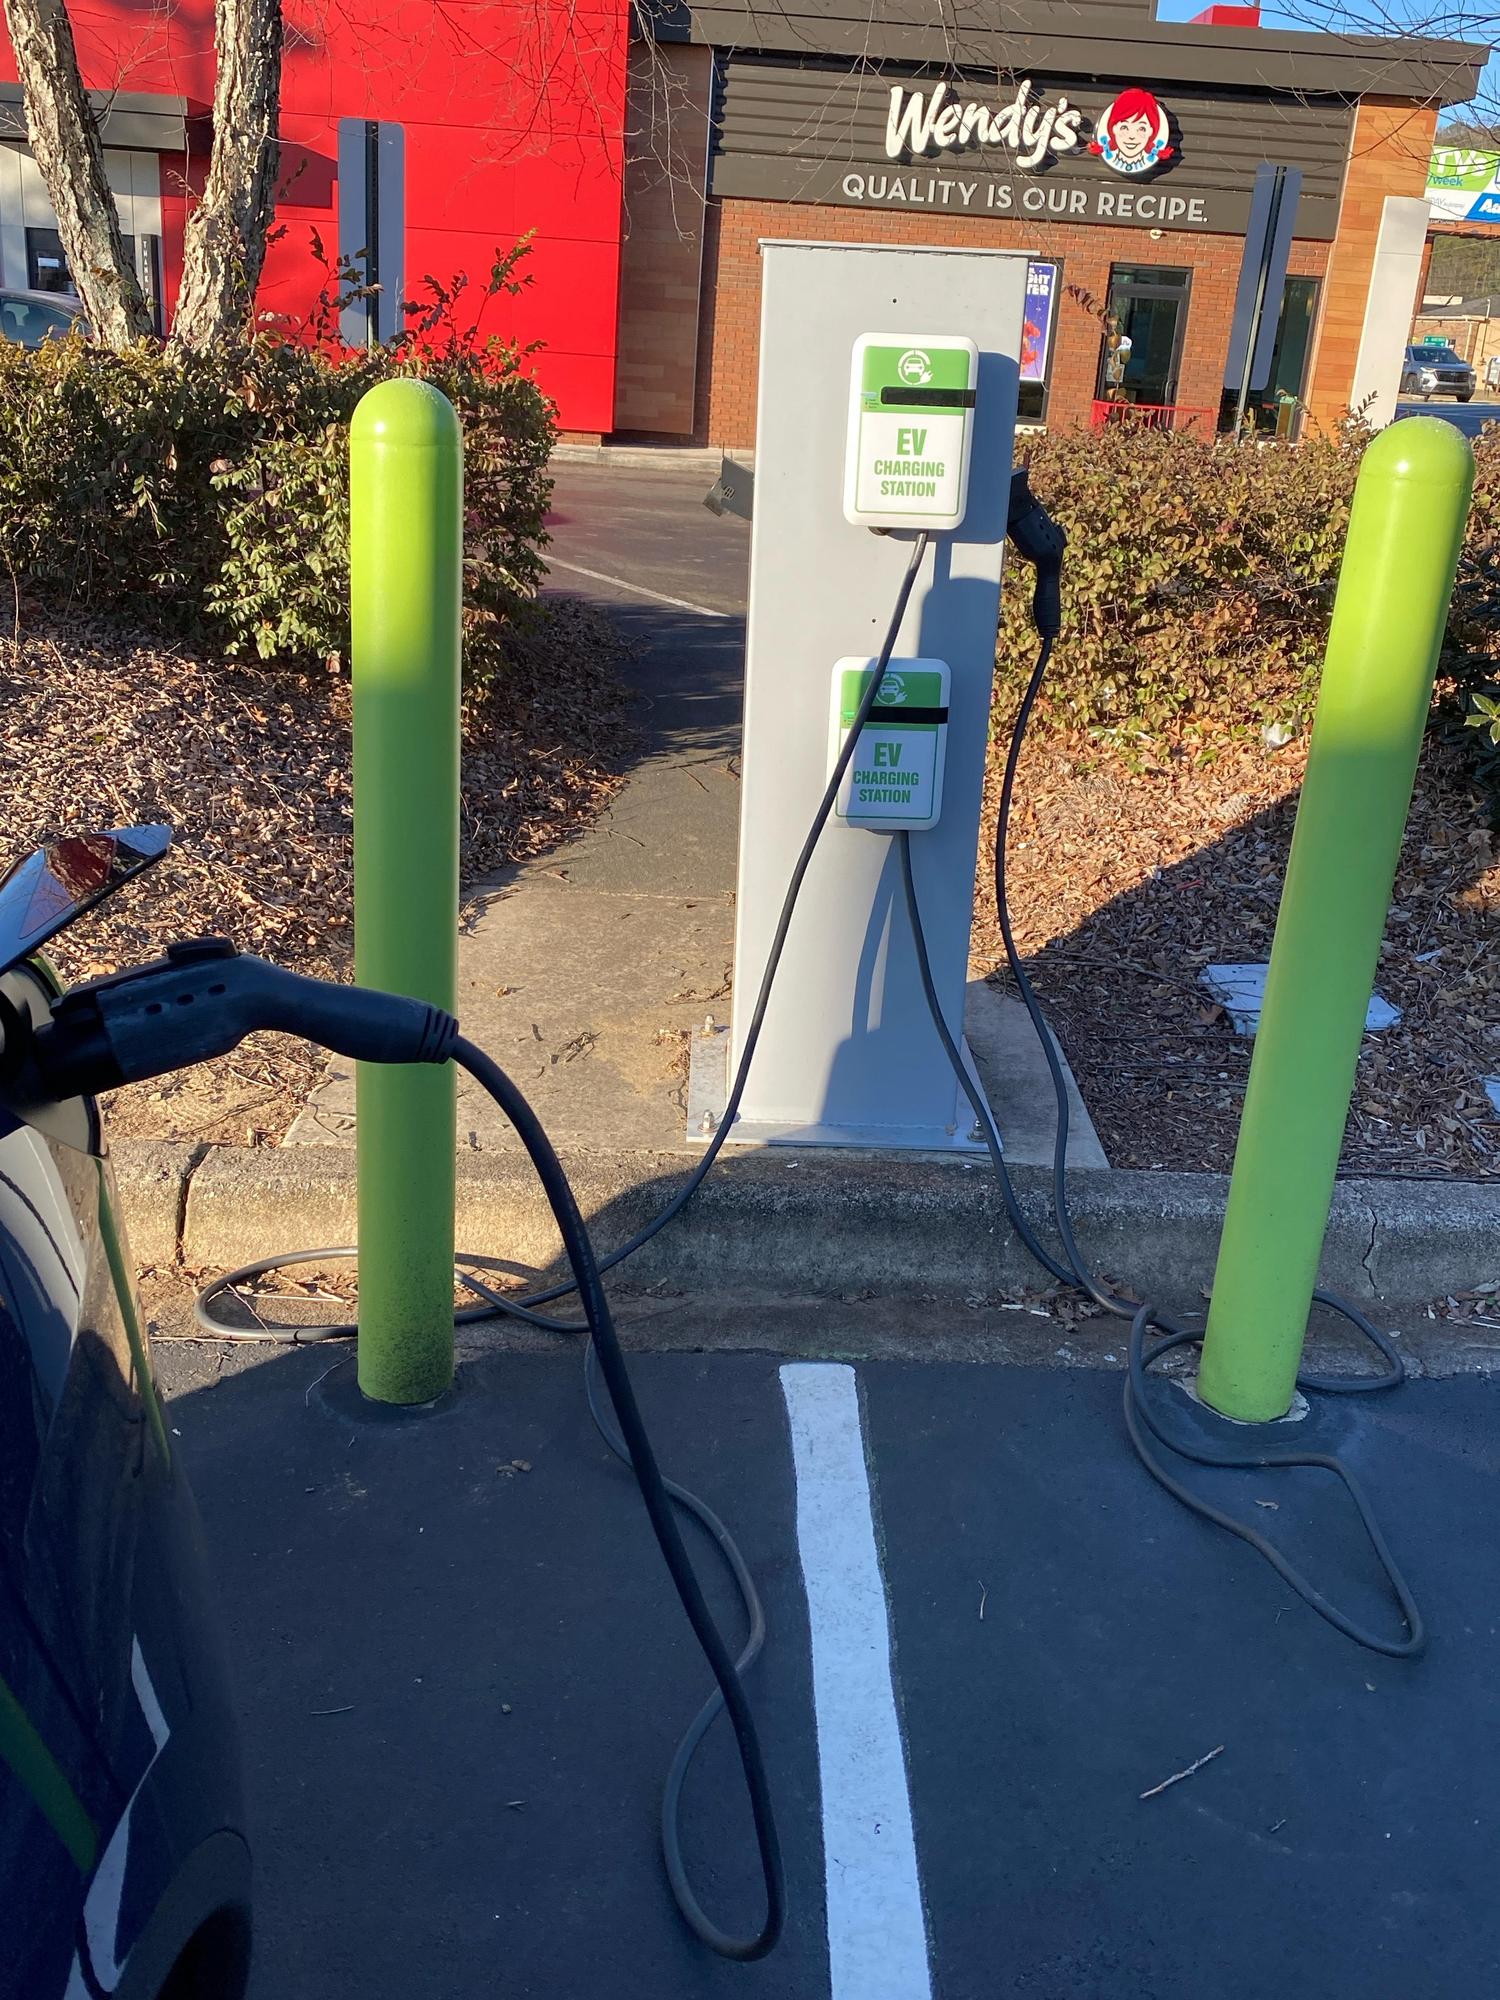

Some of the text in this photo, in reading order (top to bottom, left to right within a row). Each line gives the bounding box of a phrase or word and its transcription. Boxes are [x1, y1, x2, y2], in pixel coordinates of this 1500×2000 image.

[886, 79, 1082, 168] Wendy's
[842, 174, 1209, 223] QUALITY IS OUR RECIPE.
[896, 428, 927, 456] EV
[874, 460, 945, 477] CHARGING
[880, 480, 936, 497] STATION
[873, 743, 902, 767] EV
[853, 770, 919, 785] CHARGING
[859, 788, 911, 803] STATION
